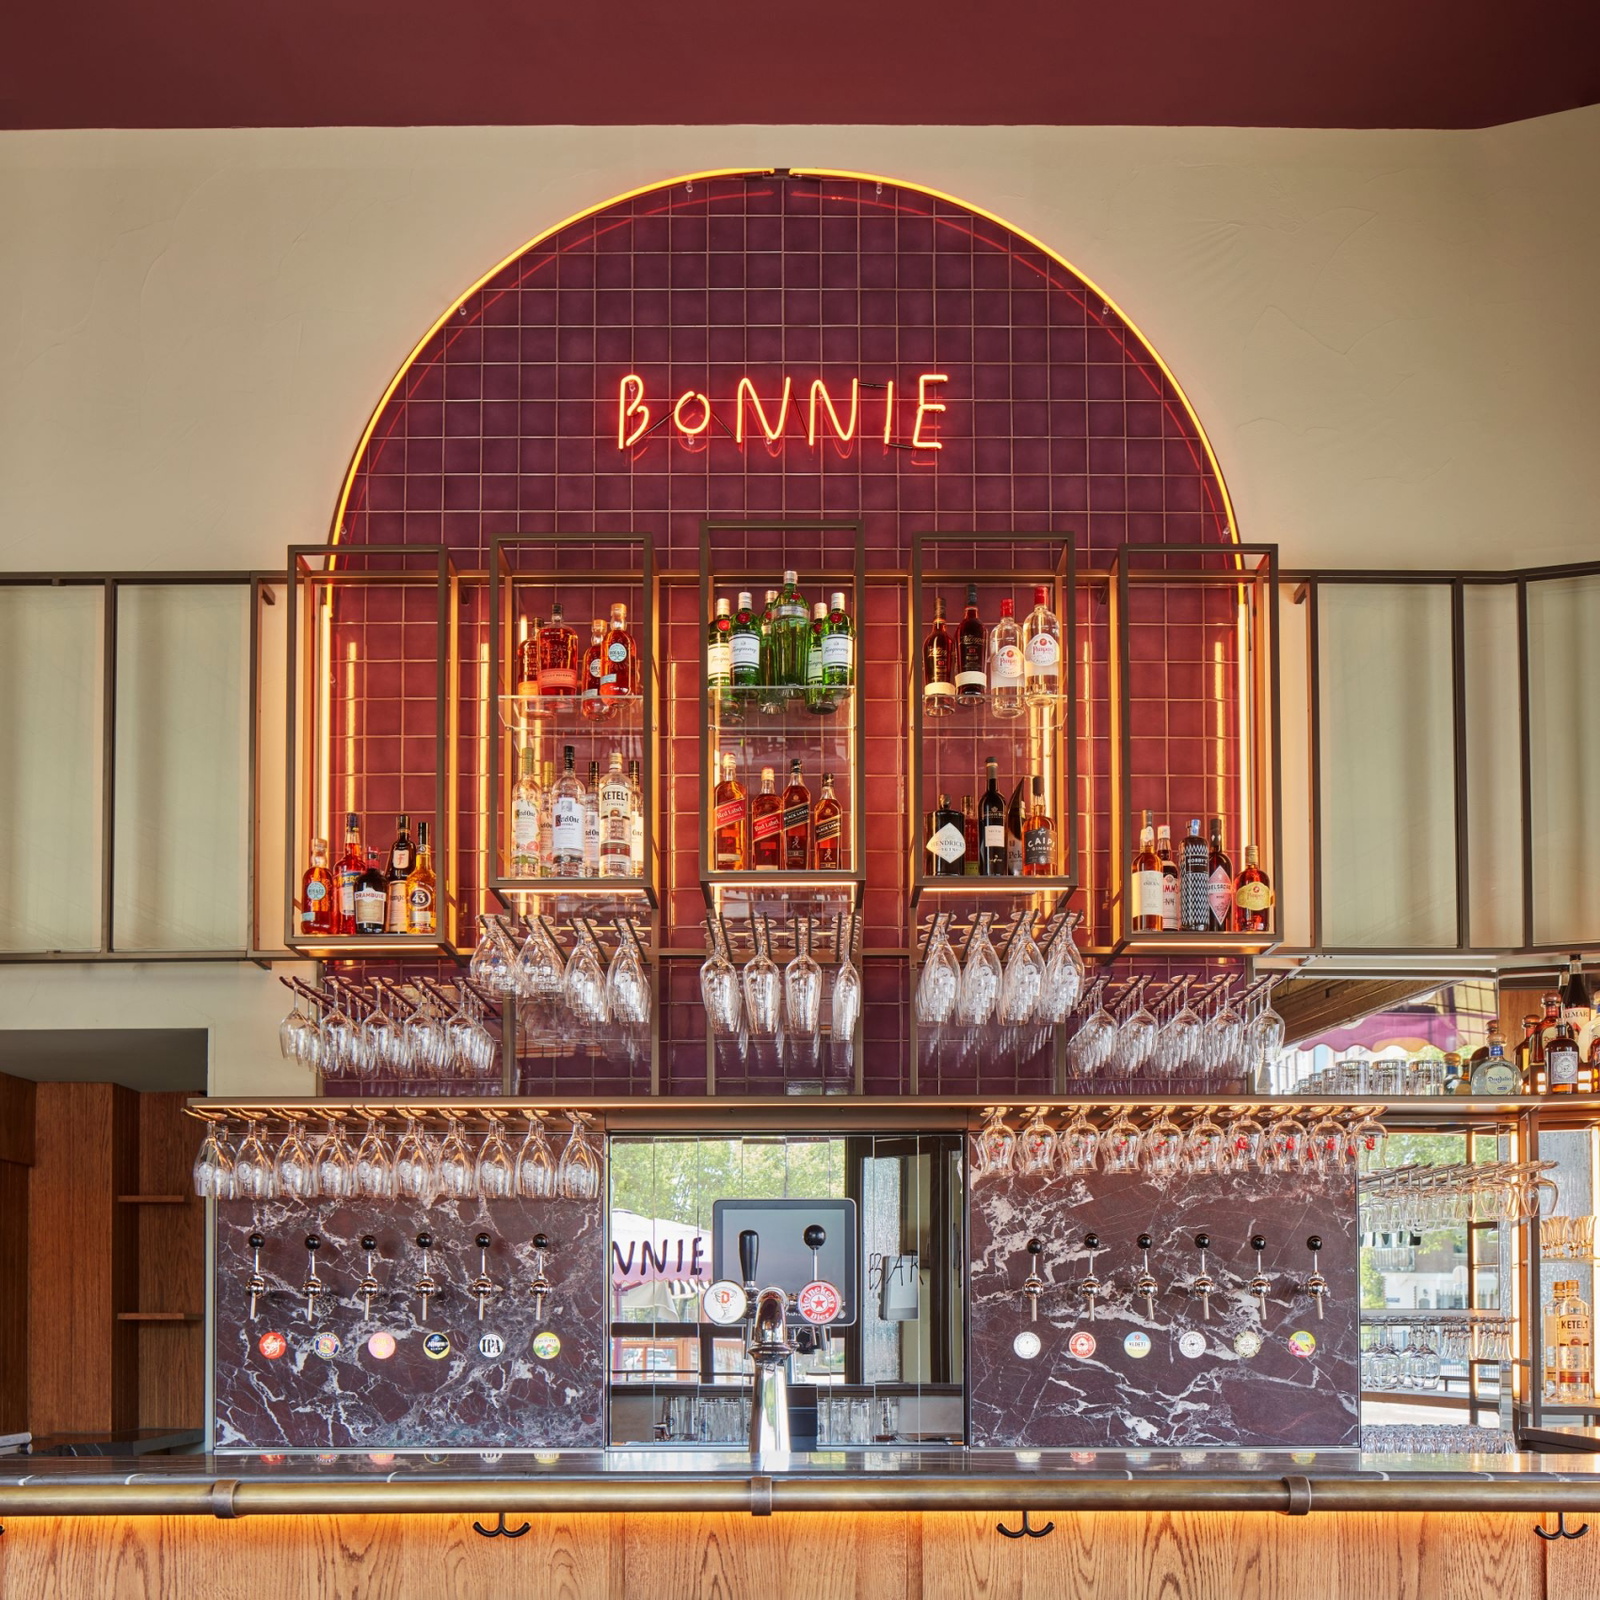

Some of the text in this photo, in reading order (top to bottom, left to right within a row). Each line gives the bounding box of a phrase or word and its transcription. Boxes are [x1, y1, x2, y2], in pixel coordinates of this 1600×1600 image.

[618, 374, 949, 451] BONNIE
[411, 893, 426, 904] 43
[482, 1338, 501, 1353] IPA
